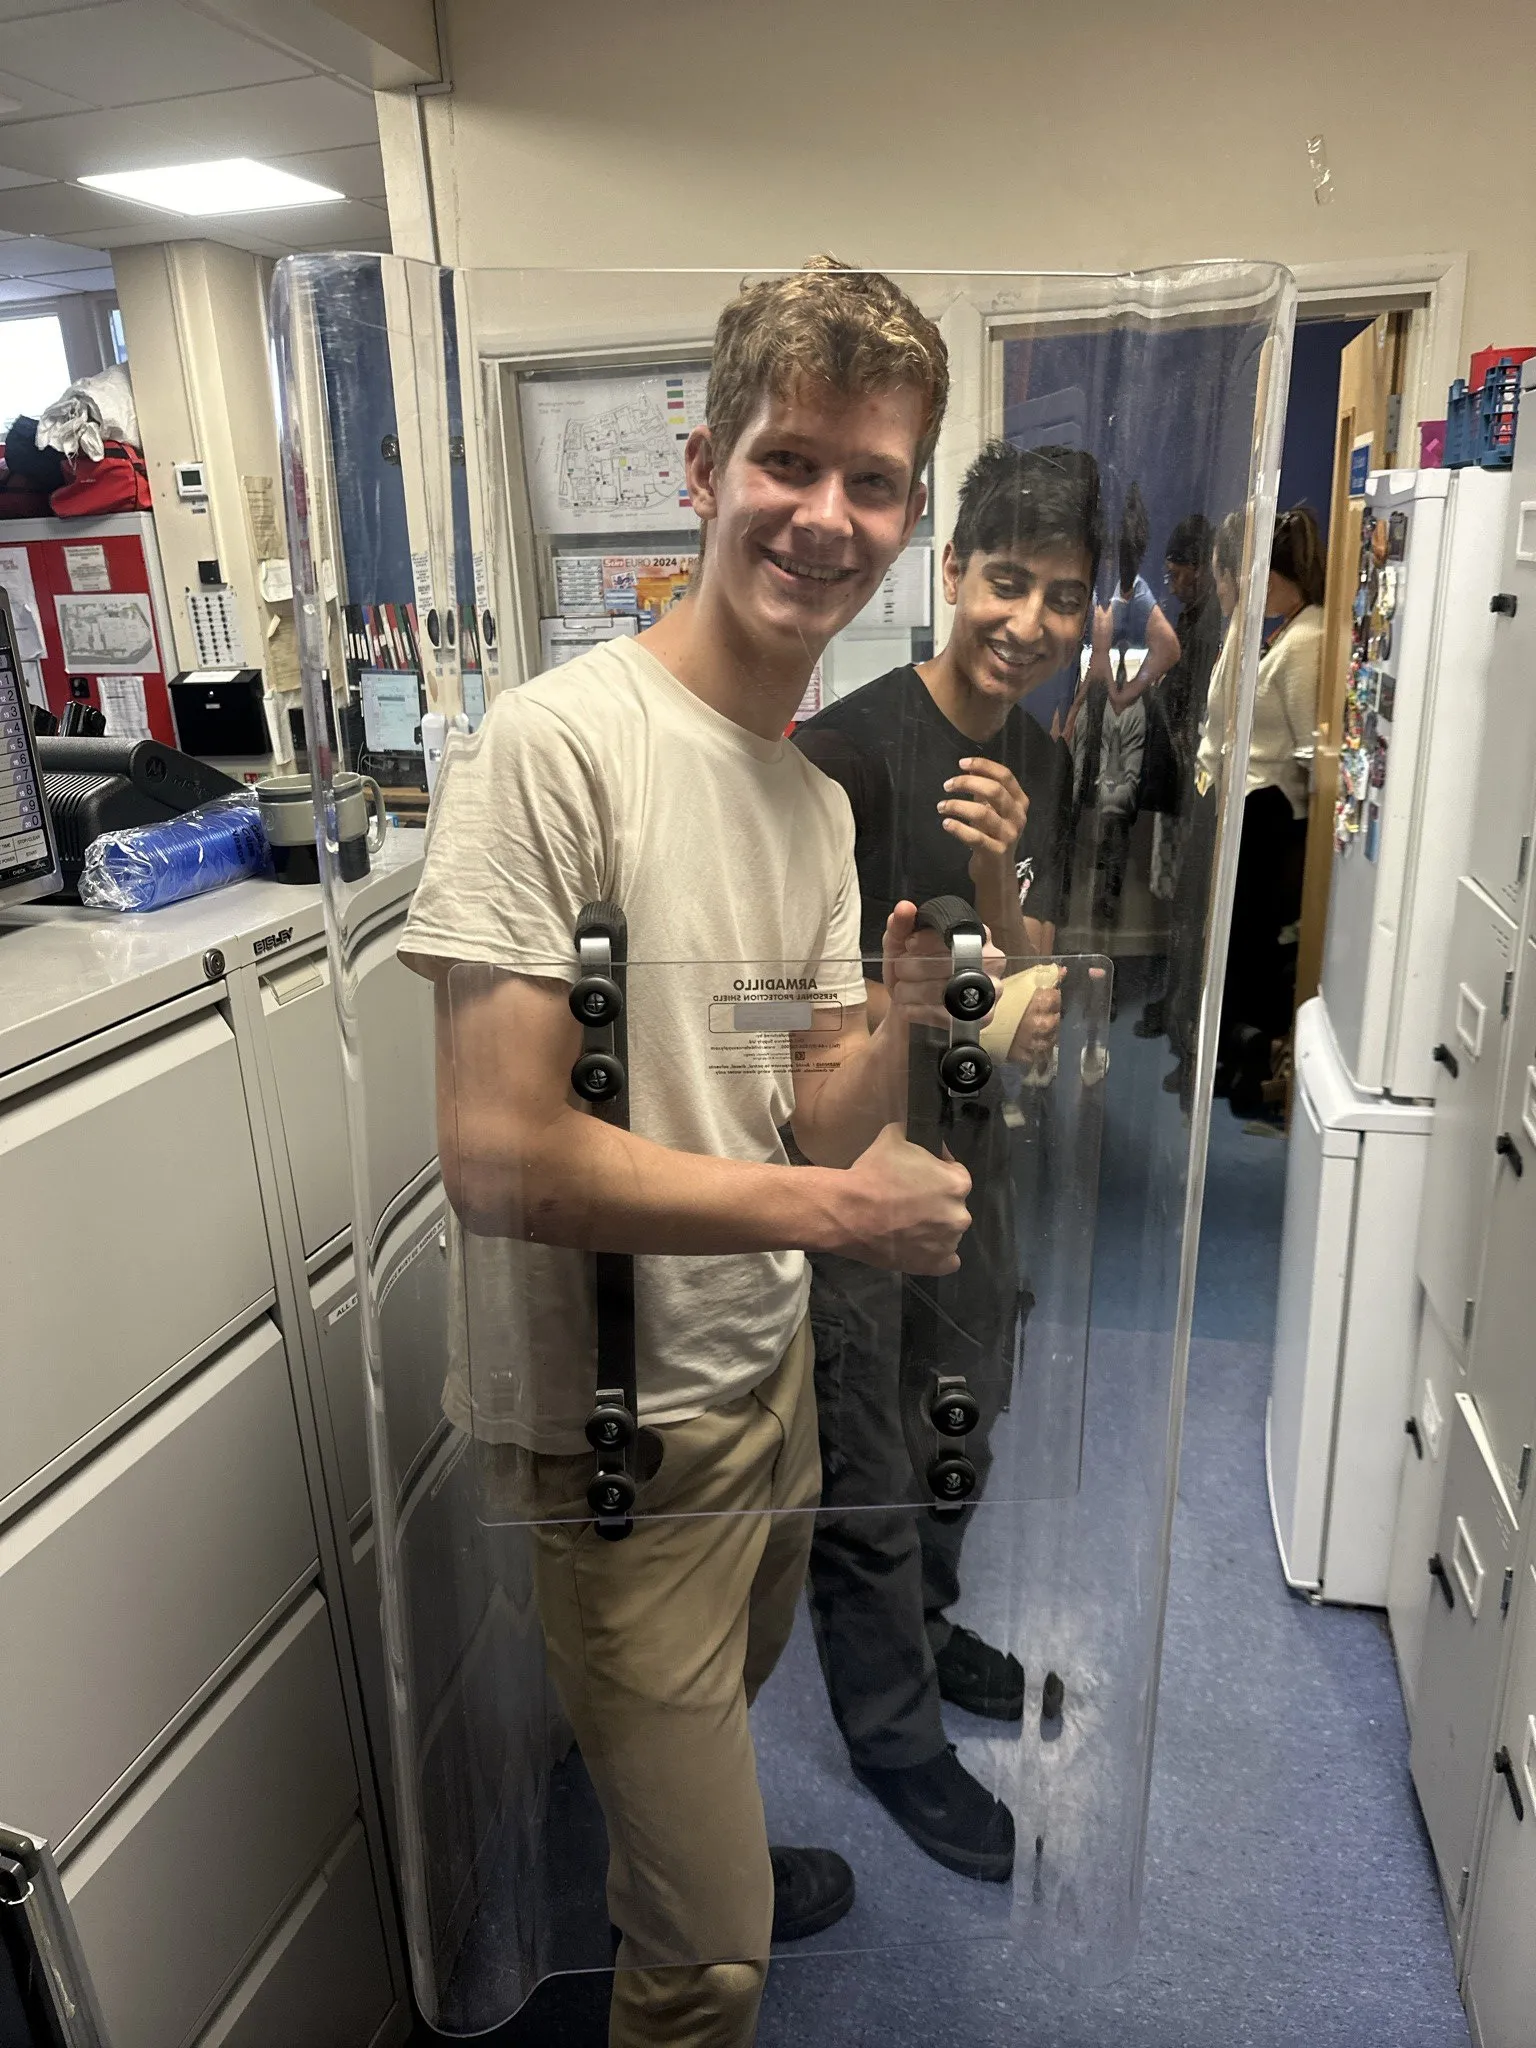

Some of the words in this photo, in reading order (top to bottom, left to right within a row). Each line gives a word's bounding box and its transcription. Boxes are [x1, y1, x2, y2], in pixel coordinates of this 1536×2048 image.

[625, 558, 651, 568] EURO
[653, 558, 678, 567] 2024
[7, 690, 15, 701] 2
[11, 706, 18, 717] 3
[14, 722, 21, 733] 4
[17, 738, 24, 749] 5
[20, 753, 27, 765] 6
[22, 768, 29, 780] 7
[26, 784, 33, 796] 8
[29, 799, 36, 811] 9
[31, 815, 39, 826] 0
[253, 927, 293, 956] BISLEY
[337, 1303, 350, 1317] ALL
